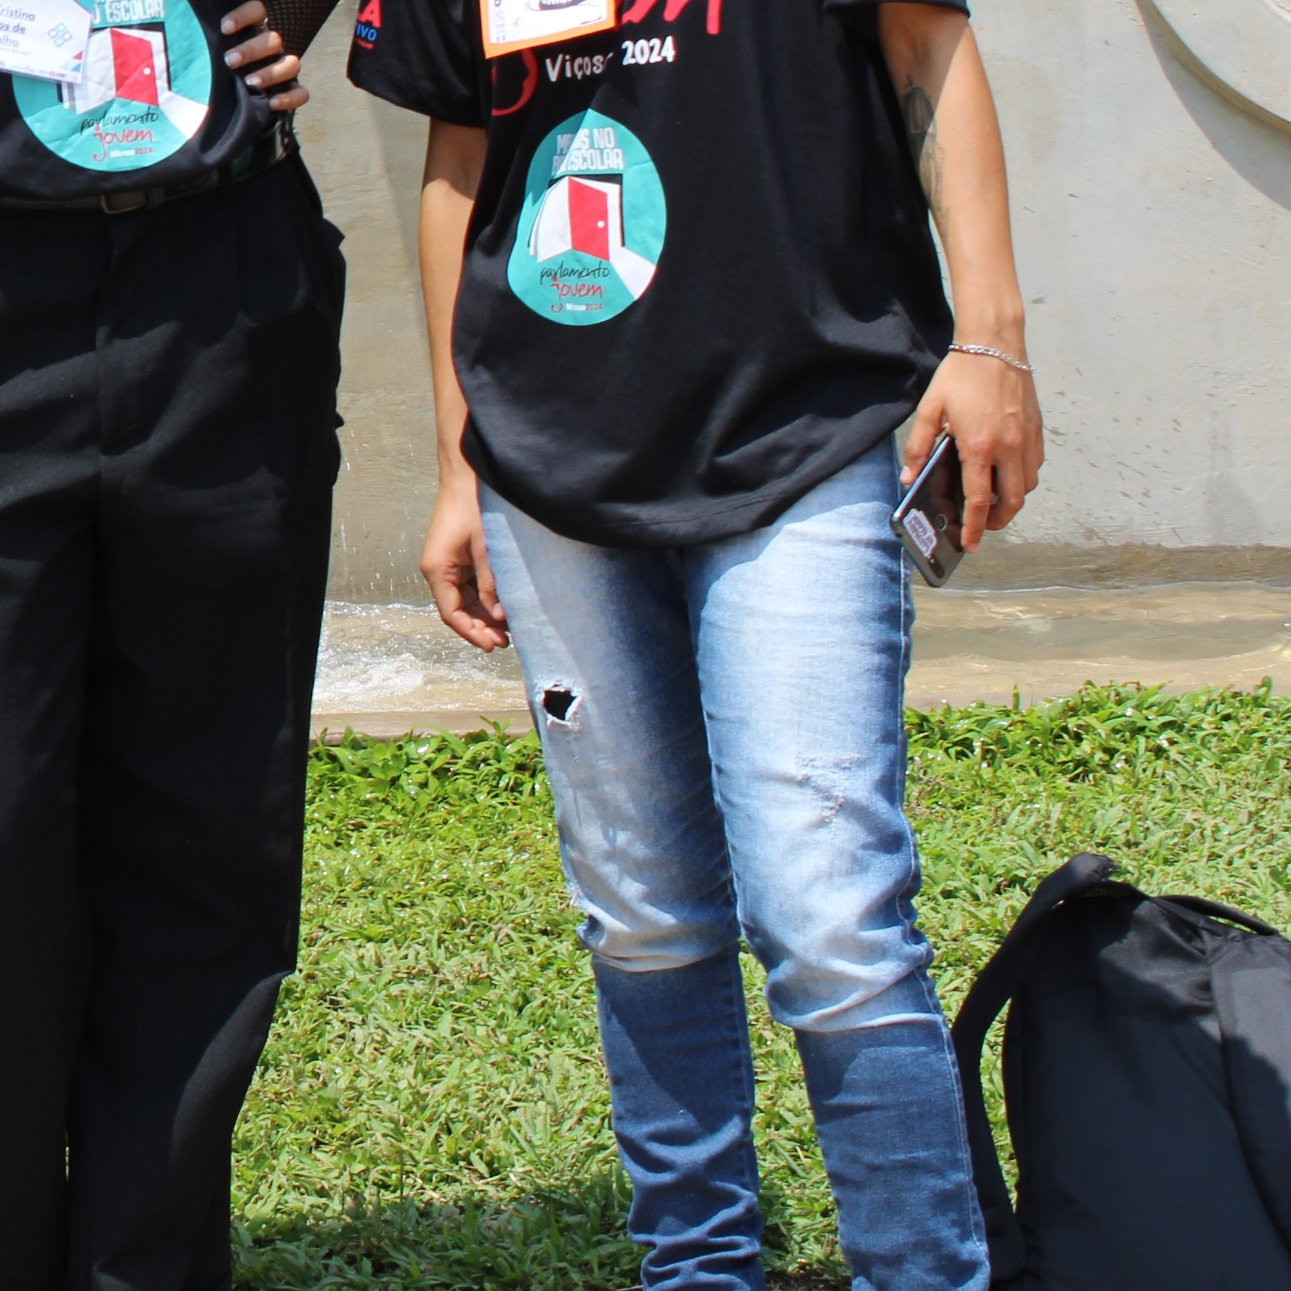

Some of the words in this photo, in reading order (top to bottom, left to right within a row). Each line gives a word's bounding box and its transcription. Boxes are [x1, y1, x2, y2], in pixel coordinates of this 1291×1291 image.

[13, 23, 26, 35] de
[621, 36, 676, 65] 2024
[80, 105, 159, 136] parlamento
[92, 125, 154, 162] jovem
[593, 127, 615, 148] NO
[540, 260, 610, 285] parlamento
[550, 274, 603, 313] jovem
